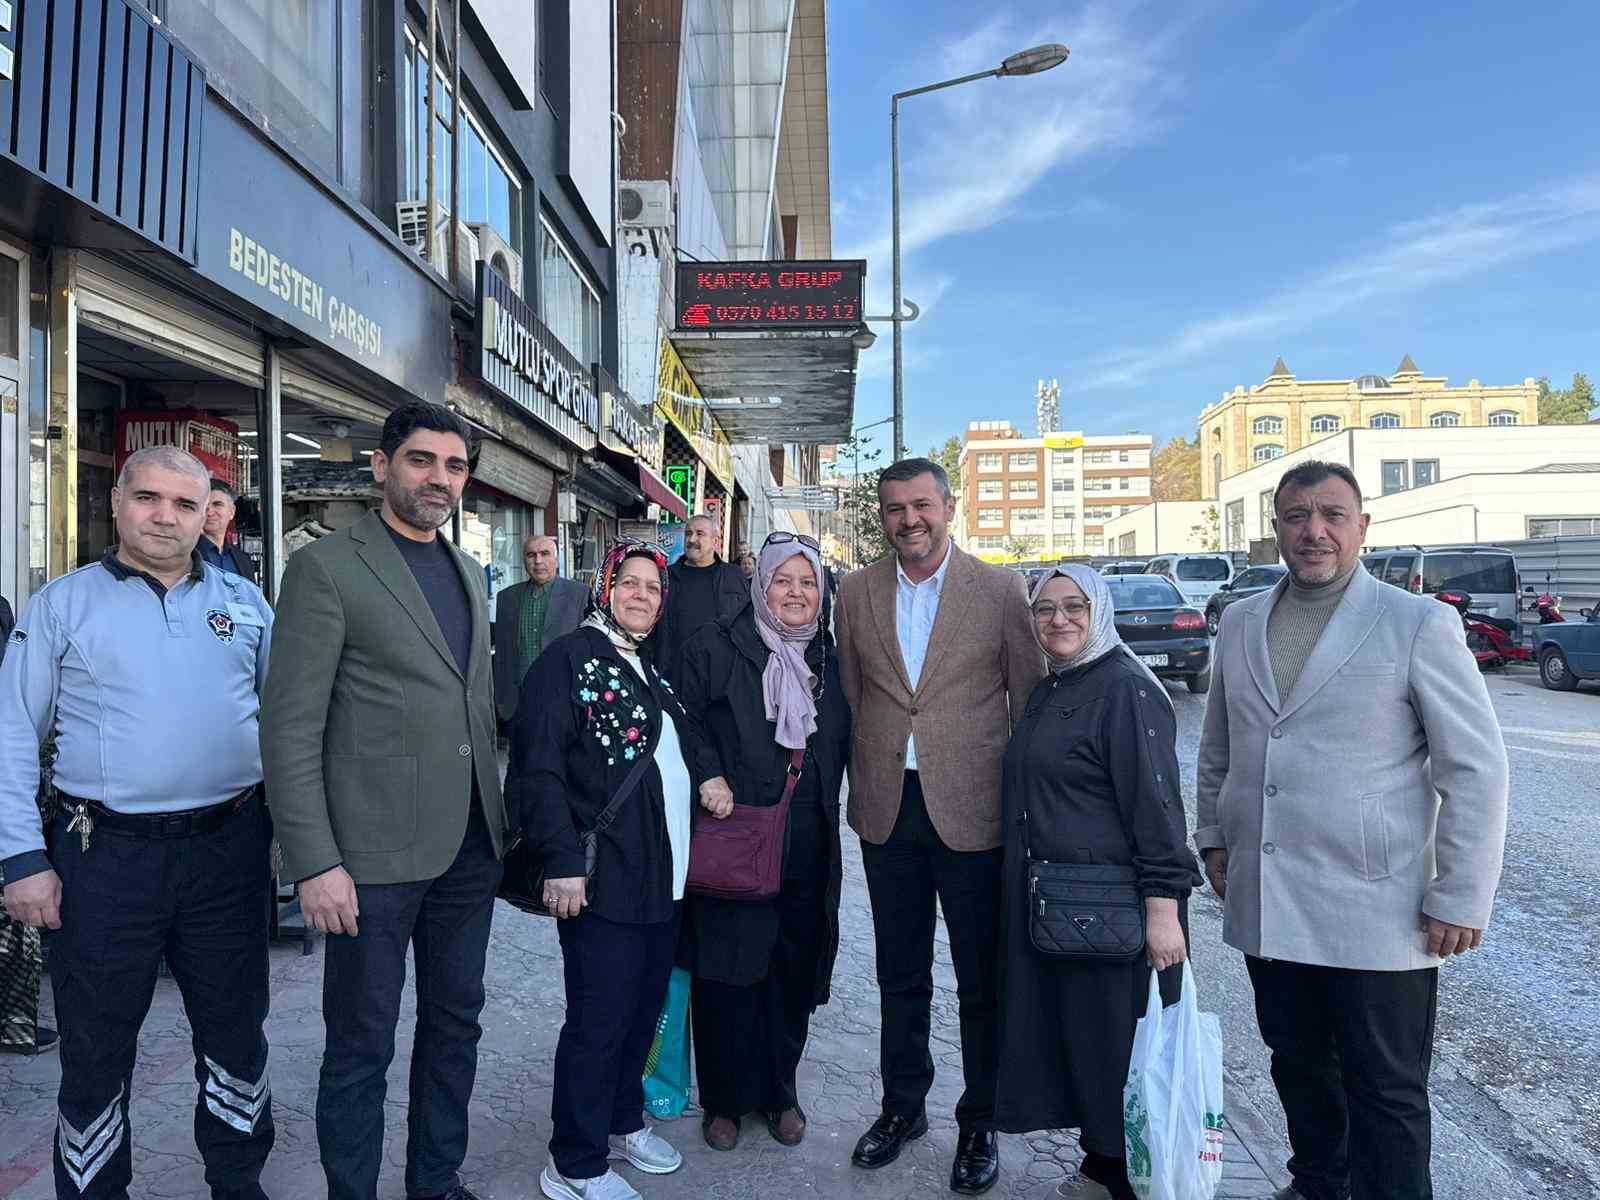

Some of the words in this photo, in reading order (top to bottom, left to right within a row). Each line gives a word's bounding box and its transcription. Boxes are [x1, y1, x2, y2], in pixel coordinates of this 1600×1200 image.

[229, 227, 324, 322] BEDESTEN
[328, 295, 382, 358] ÇARŞISI
[697, 271, 772, 289] KAFKA
[778, 271, 843, 289] GRUP
[716, 305, 762, 321] 0370
[766, 304, 800, 321] 415
[832, 303, 857, 321] 12
[490, 299, 540, 385] MUTLU
[542, 348, 572, 412] SPOR
